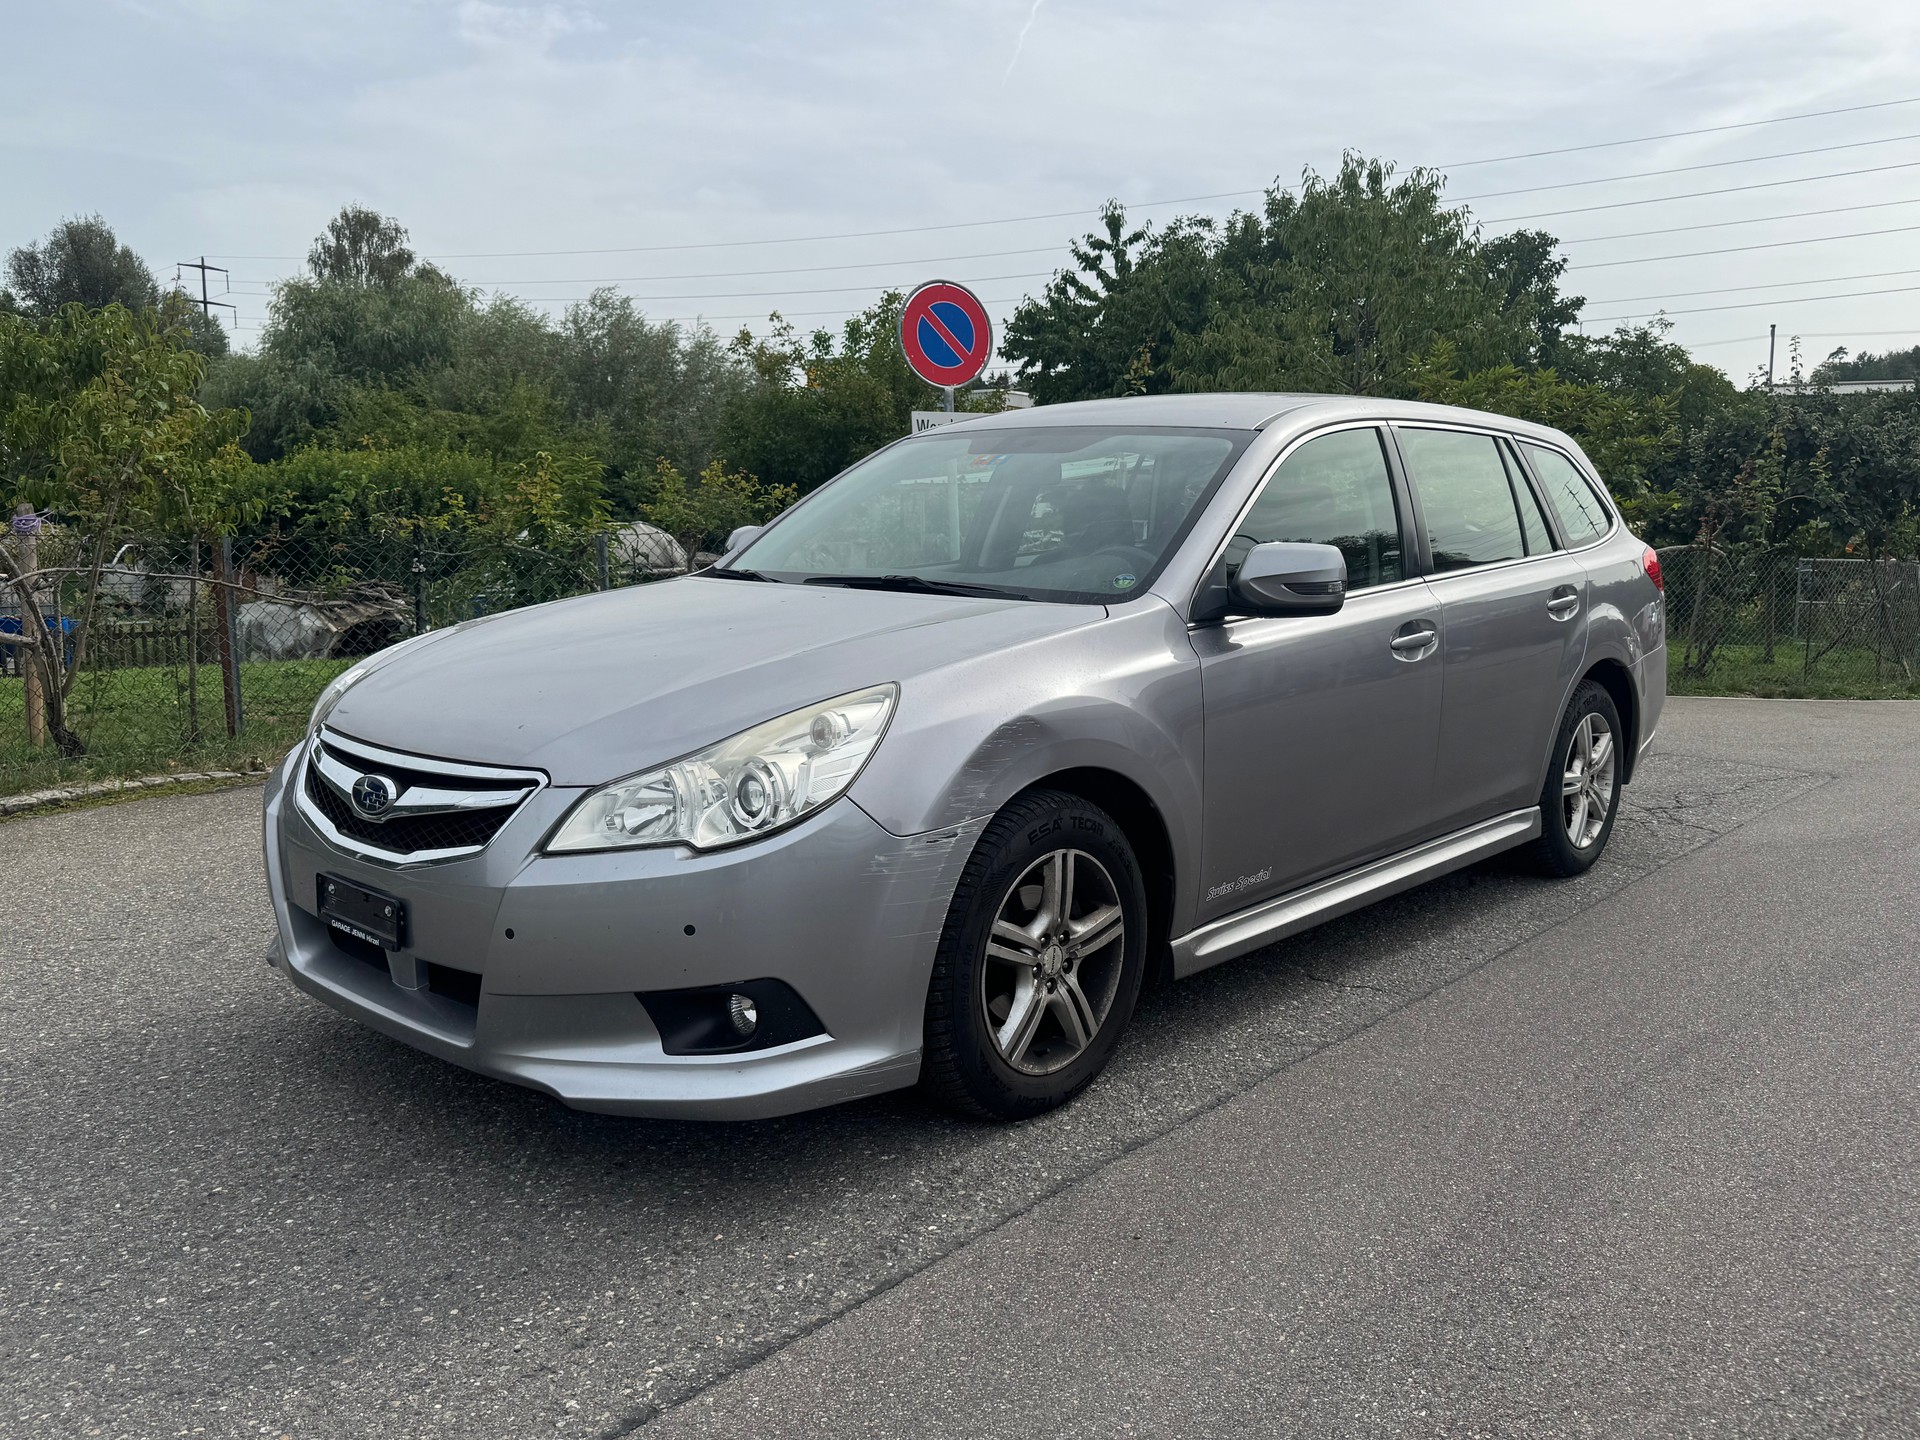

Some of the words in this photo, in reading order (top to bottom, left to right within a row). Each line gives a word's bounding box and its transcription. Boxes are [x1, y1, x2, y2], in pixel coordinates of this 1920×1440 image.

[1070, 816, 1105, 837] TECAR
[1206, 882, 1235, 901] Swiss
[1235, 866, 1272, 891] Special
[331, 919, 351, 934] GARAGE
[351, 928, 366, 940] JENNI
[366, 934, 380, 946] Hirzel
